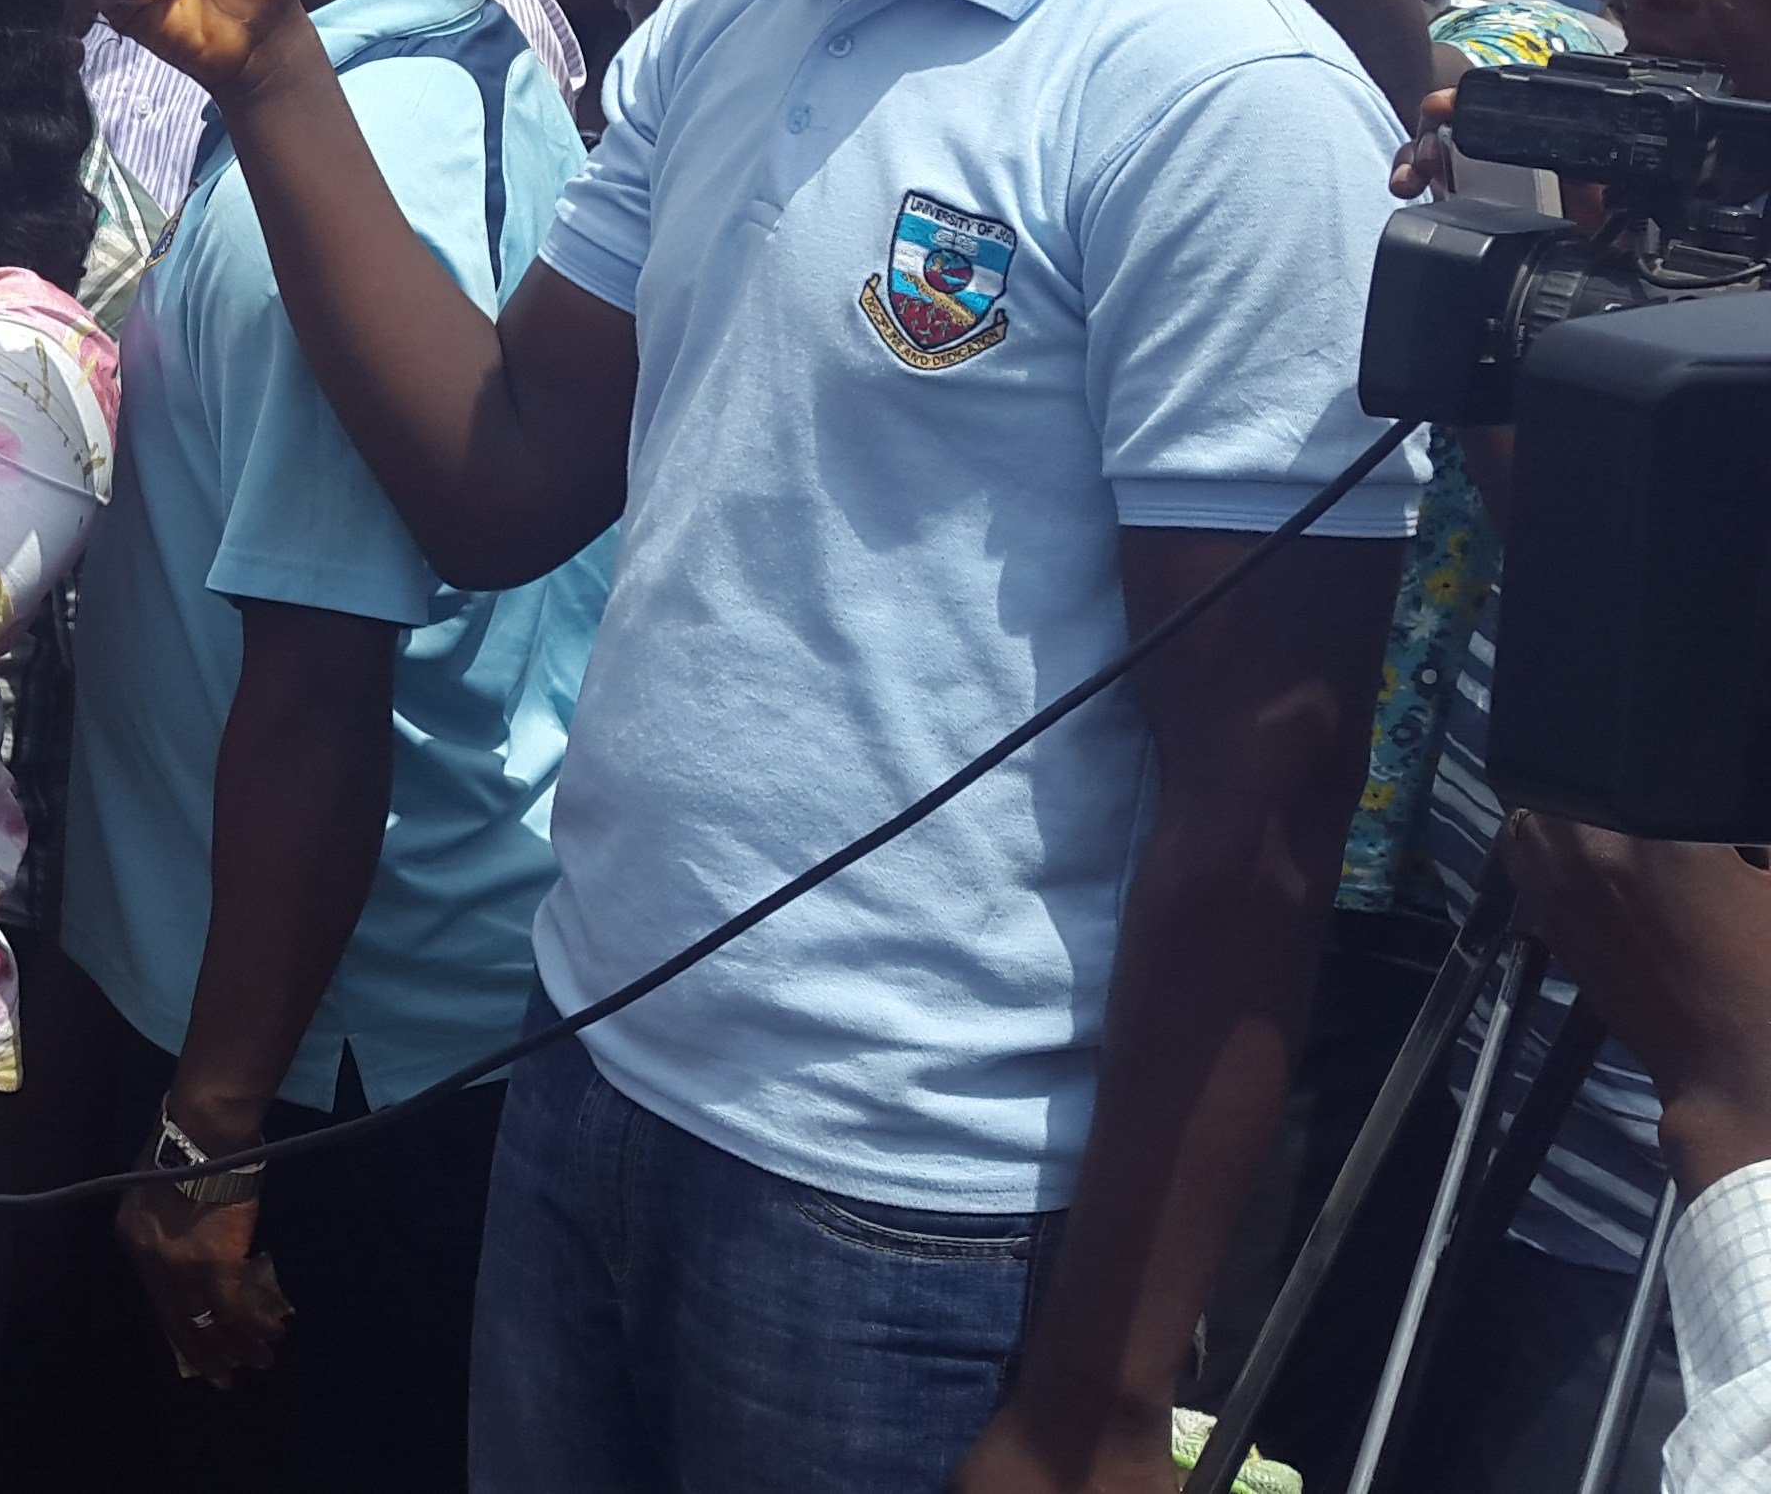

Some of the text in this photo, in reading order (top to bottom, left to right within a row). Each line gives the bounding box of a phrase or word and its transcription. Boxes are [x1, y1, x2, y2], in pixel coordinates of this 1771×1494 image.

[910, 196, 972, 233] UNIVERSITY
[977, 222, 997, 237] OF
[904, 347, 930, 367] AND
[932, 328, 1000, 367] DEDICATION
